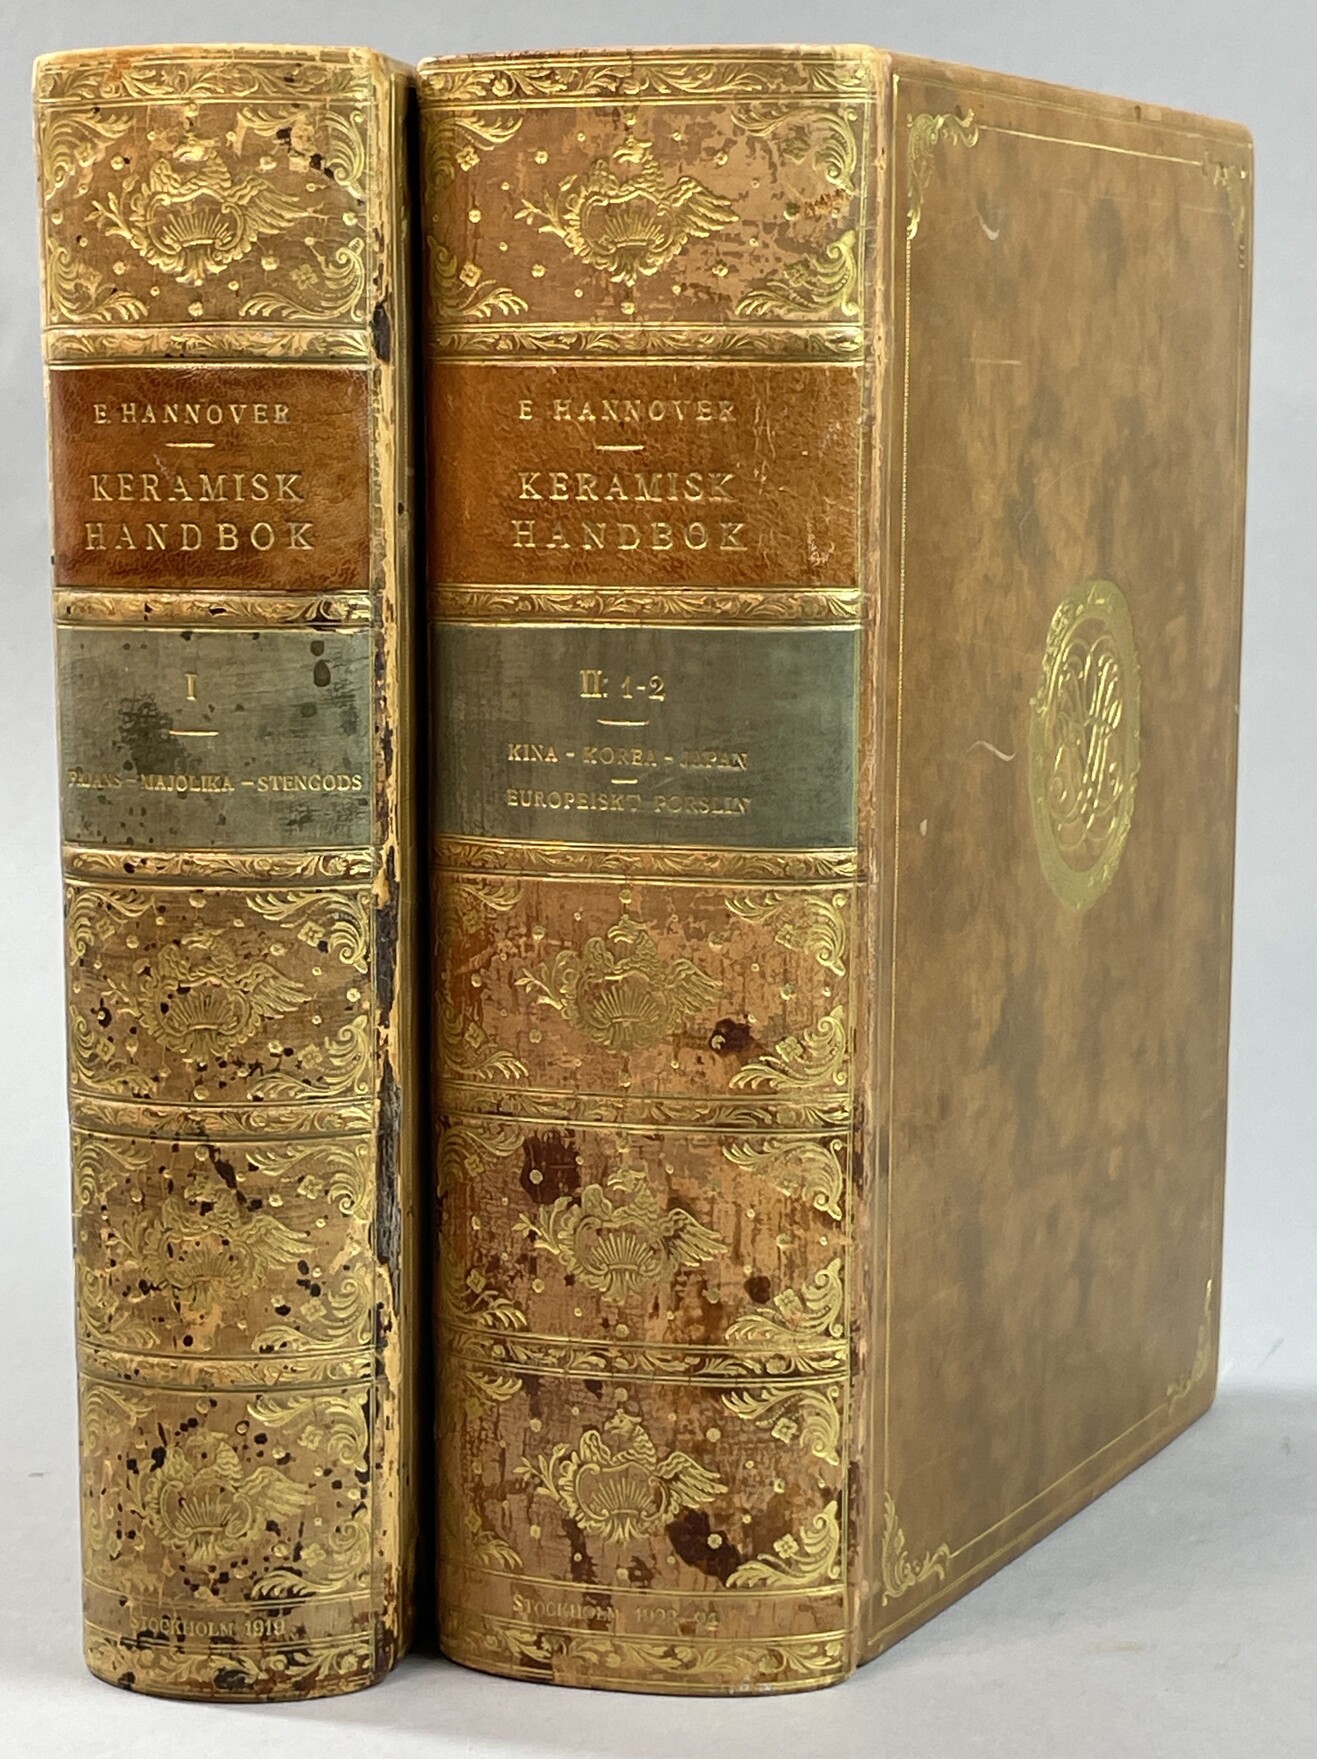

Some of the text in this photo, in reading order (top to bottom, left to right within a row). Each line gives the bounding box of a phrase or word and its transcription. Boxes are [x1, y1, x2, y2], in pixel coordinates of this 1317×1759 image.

[121, 402, 291, 424] HANNOVER
[553, 399, 736, 421] HANNOVER
[90, 473, 304, 501] KERAMISK
[518, 472, 737, 502] KERAMISK
[84, 521, 315, 551] HANDBOK
[511, 519, 748, 551] HANDBOK
[185, 672, 198, 701] I
[507, 743, 559, 762] KINA
[257, 773, 363, 792] STENGODS
[130, 1614, 286, 1638] STOCKHOLM 1919
